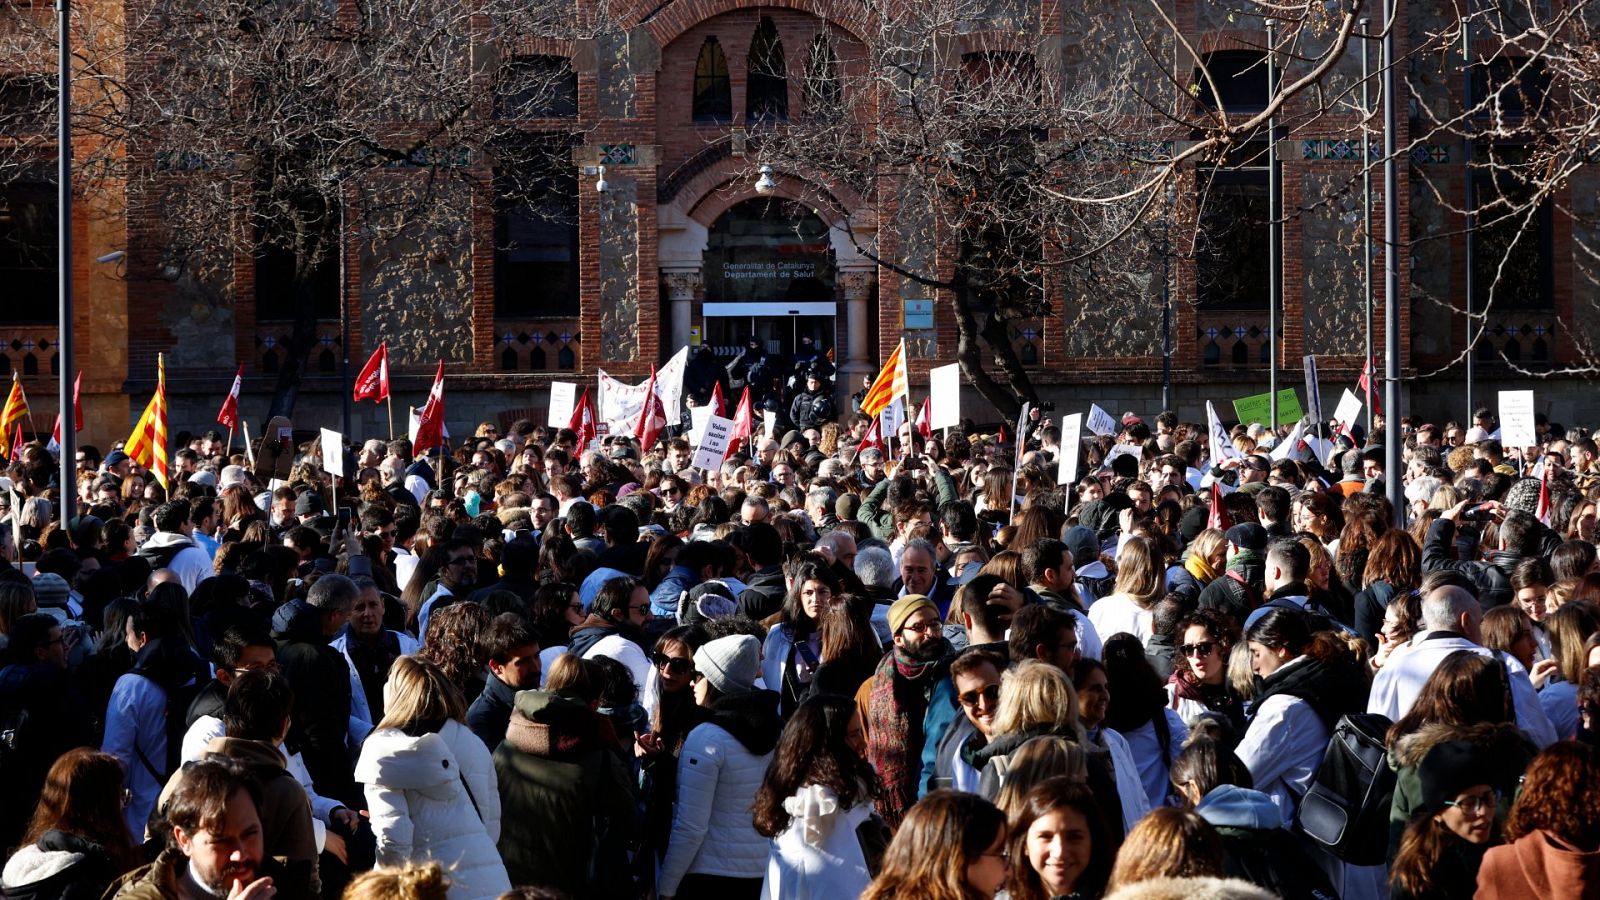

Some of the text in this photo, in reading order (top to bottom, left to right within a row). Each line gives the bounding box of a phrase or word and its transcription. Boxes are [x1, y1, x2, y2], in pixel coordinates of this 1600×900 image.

[723, 262, 815, 271] Generalitat de Catalunya
[724, 270, 815, 279] Departament de Salut
[712, 422, 727, 431] Volem
[708, 431, 726, 439] sanitat
[699, 445, 724, 455] precarietat
